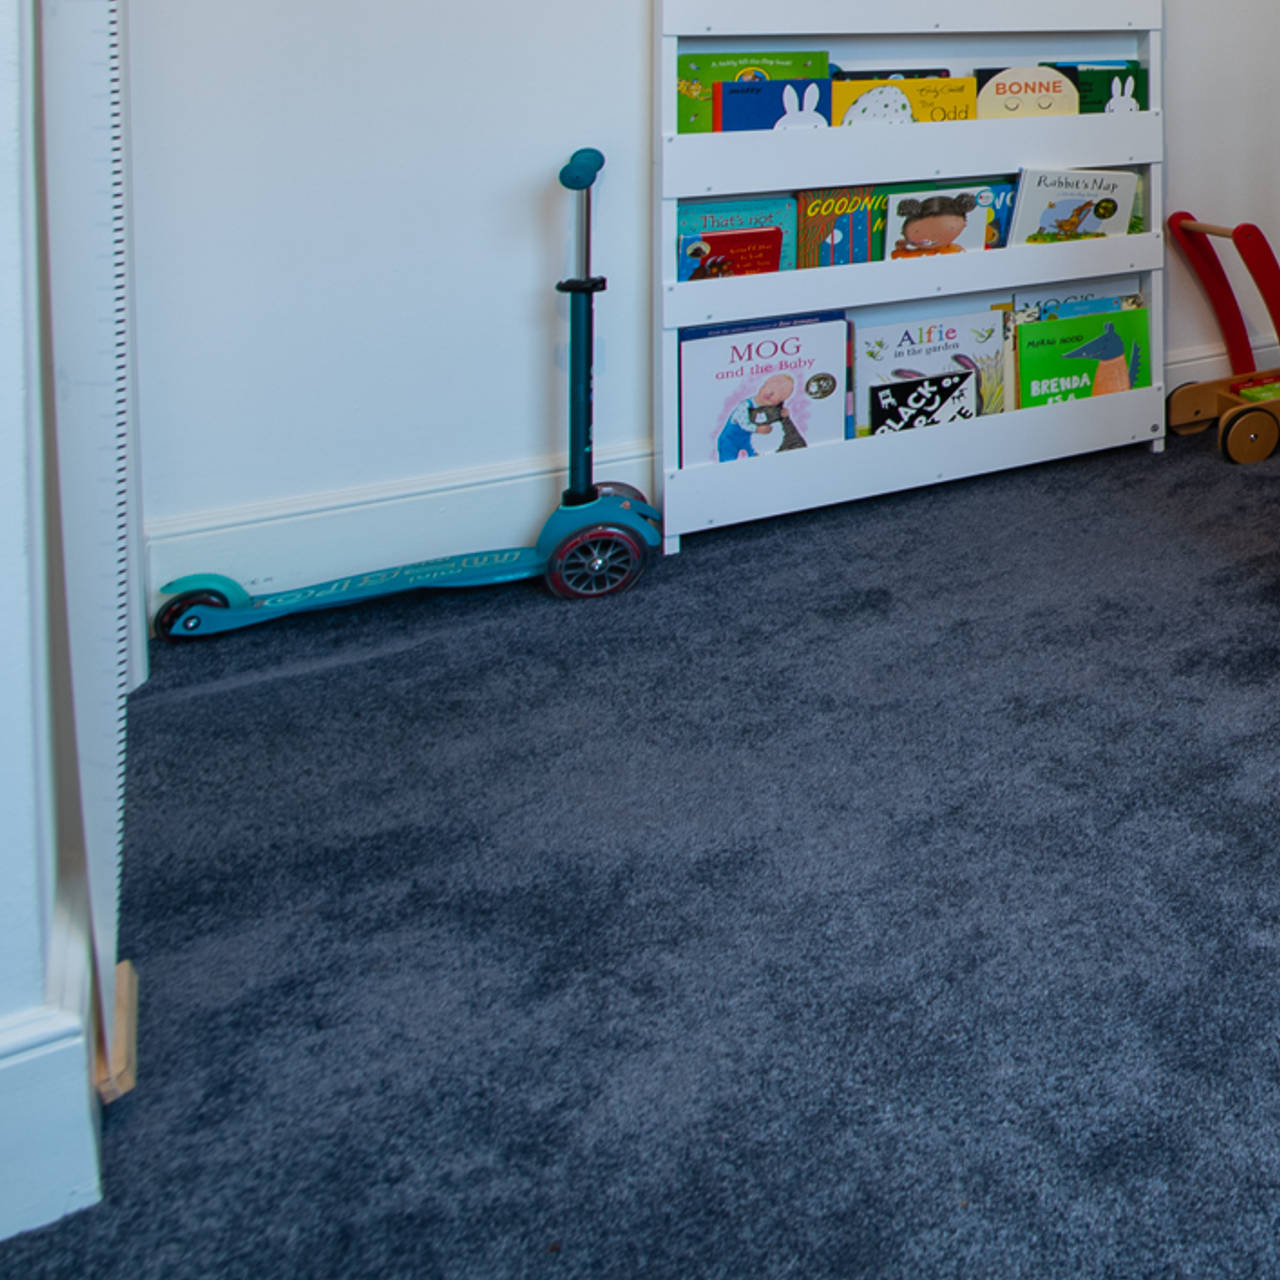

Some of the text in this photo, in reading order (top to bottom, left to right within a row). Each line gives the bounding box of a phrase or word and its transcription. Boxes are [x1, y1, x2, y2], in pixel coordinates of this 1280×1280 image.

[994, 79, 1064, 96] BONNE
[930, 103, 970, 122] Odd
[1037, 174, 1120, 194] Rabbit's Nap
[897, 323, 958, 348] Alfie
[729, 336, 802, 364] MOG
[894, 341, 960, 359] in the garden
[715, 356, 816, 381] and the Baby
[1030, 372, 1092, 398] BRENDA
